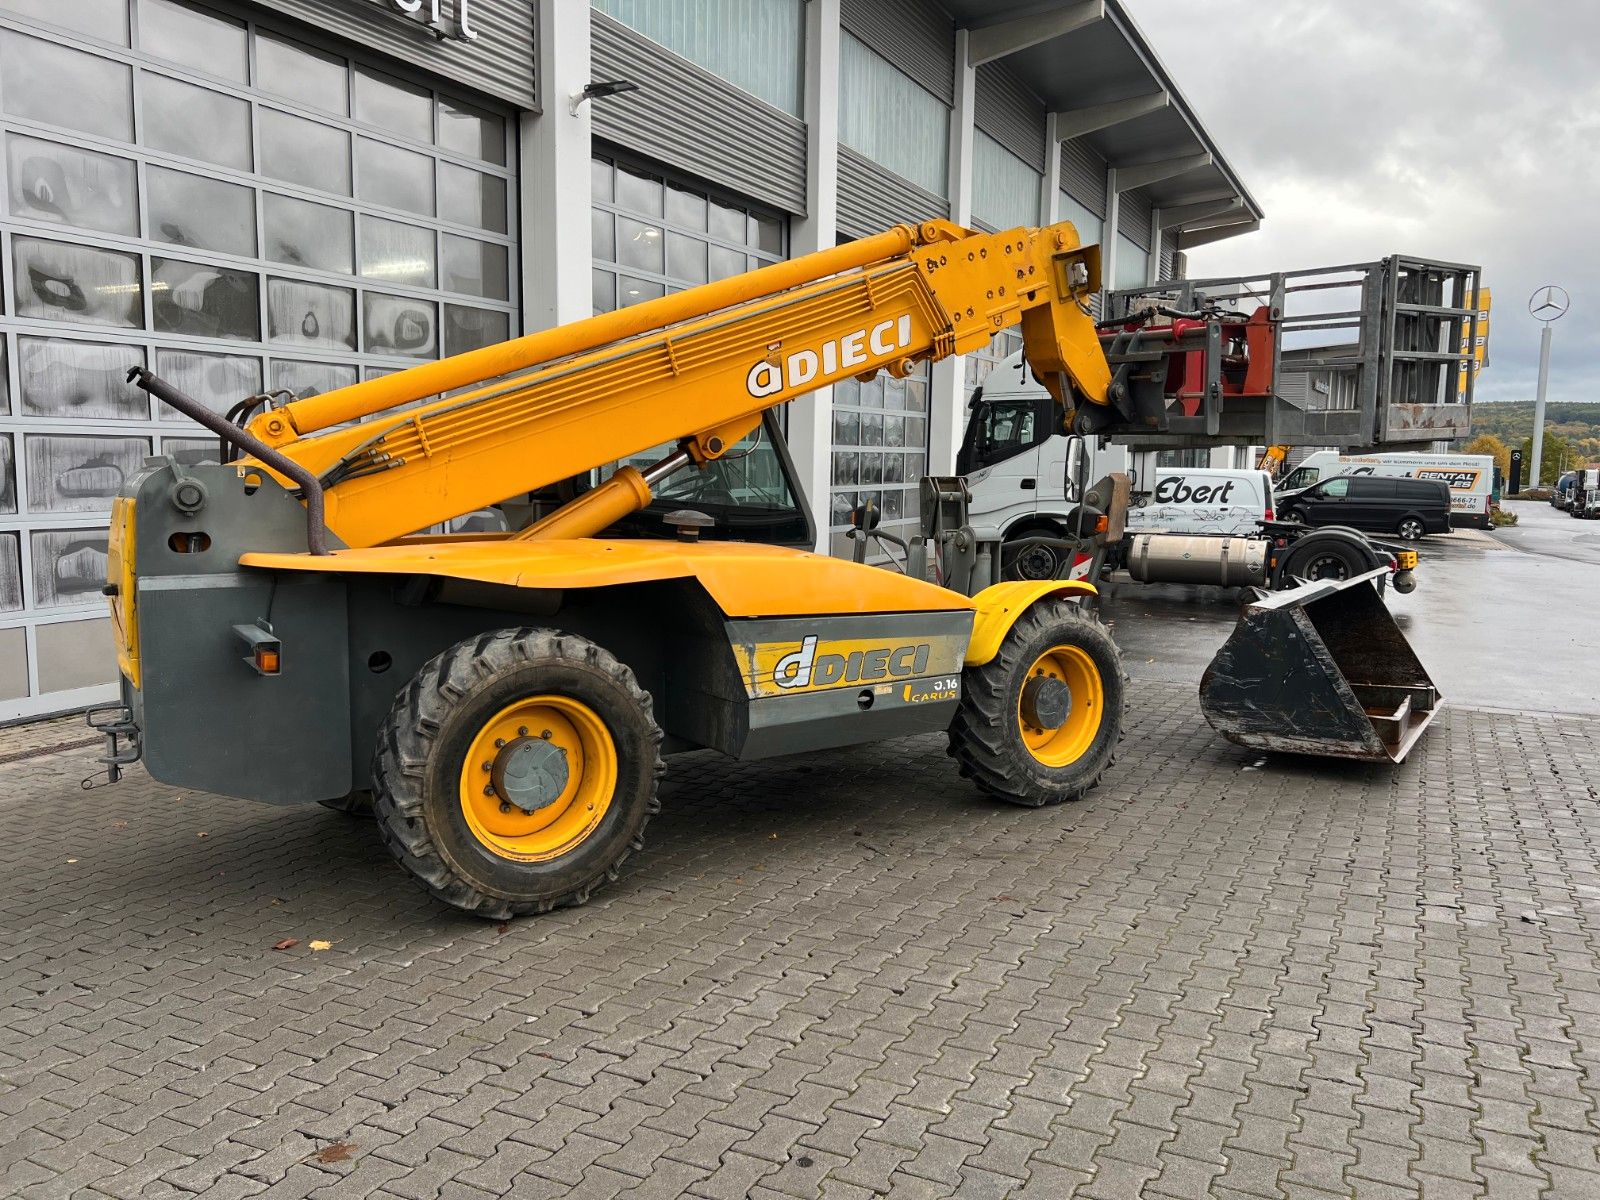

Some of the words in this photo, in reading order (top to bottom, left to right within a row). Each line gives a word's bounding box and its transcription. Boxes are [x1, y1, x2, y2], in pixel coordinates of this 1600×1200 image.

[1418, 471, 1475, 480] RENTAL
[1156, 476, 1235, 504] Ebert
[814, 644, 930, 686] DIECI
